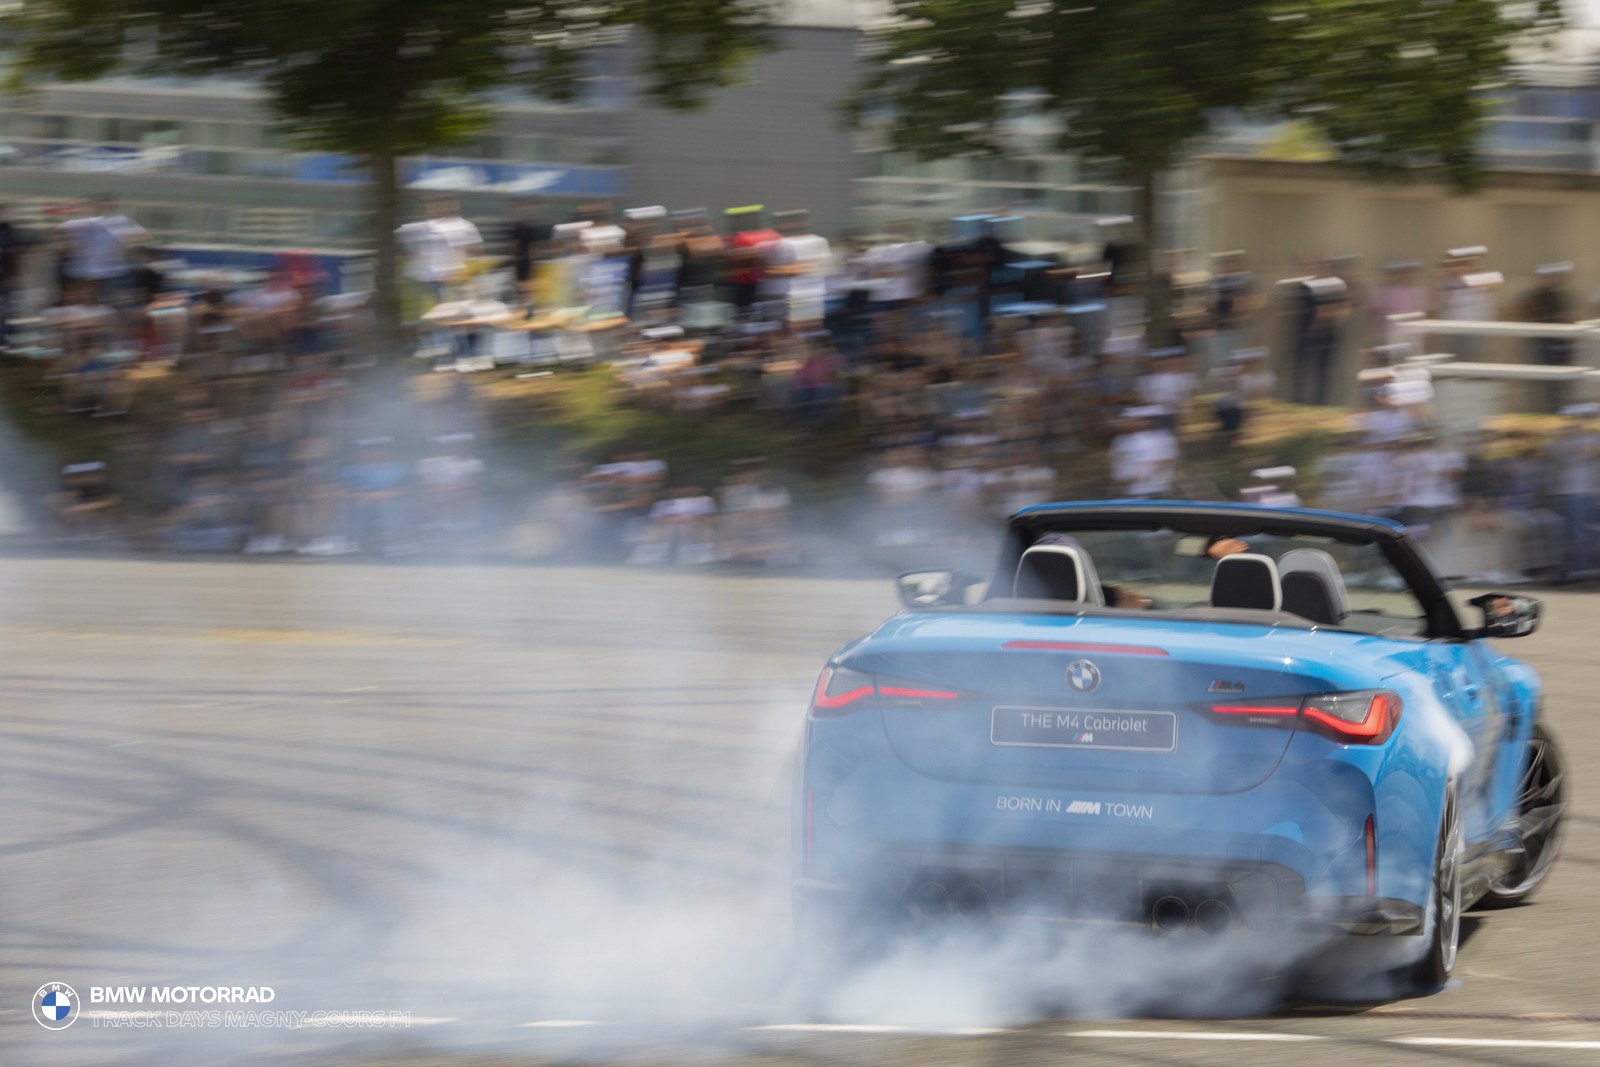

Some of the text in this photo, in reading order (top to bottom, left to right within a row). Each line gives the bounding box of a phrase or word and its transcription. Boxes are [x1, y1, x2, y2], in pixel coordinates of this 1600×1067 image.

[1021, 713, 1148, 732] THE M4 Cabriolet
[996, 796, 1042, 811] BORN
[1046, 800, 1061, 812] IN
[1105, 803, 1153, 819] TOWN
